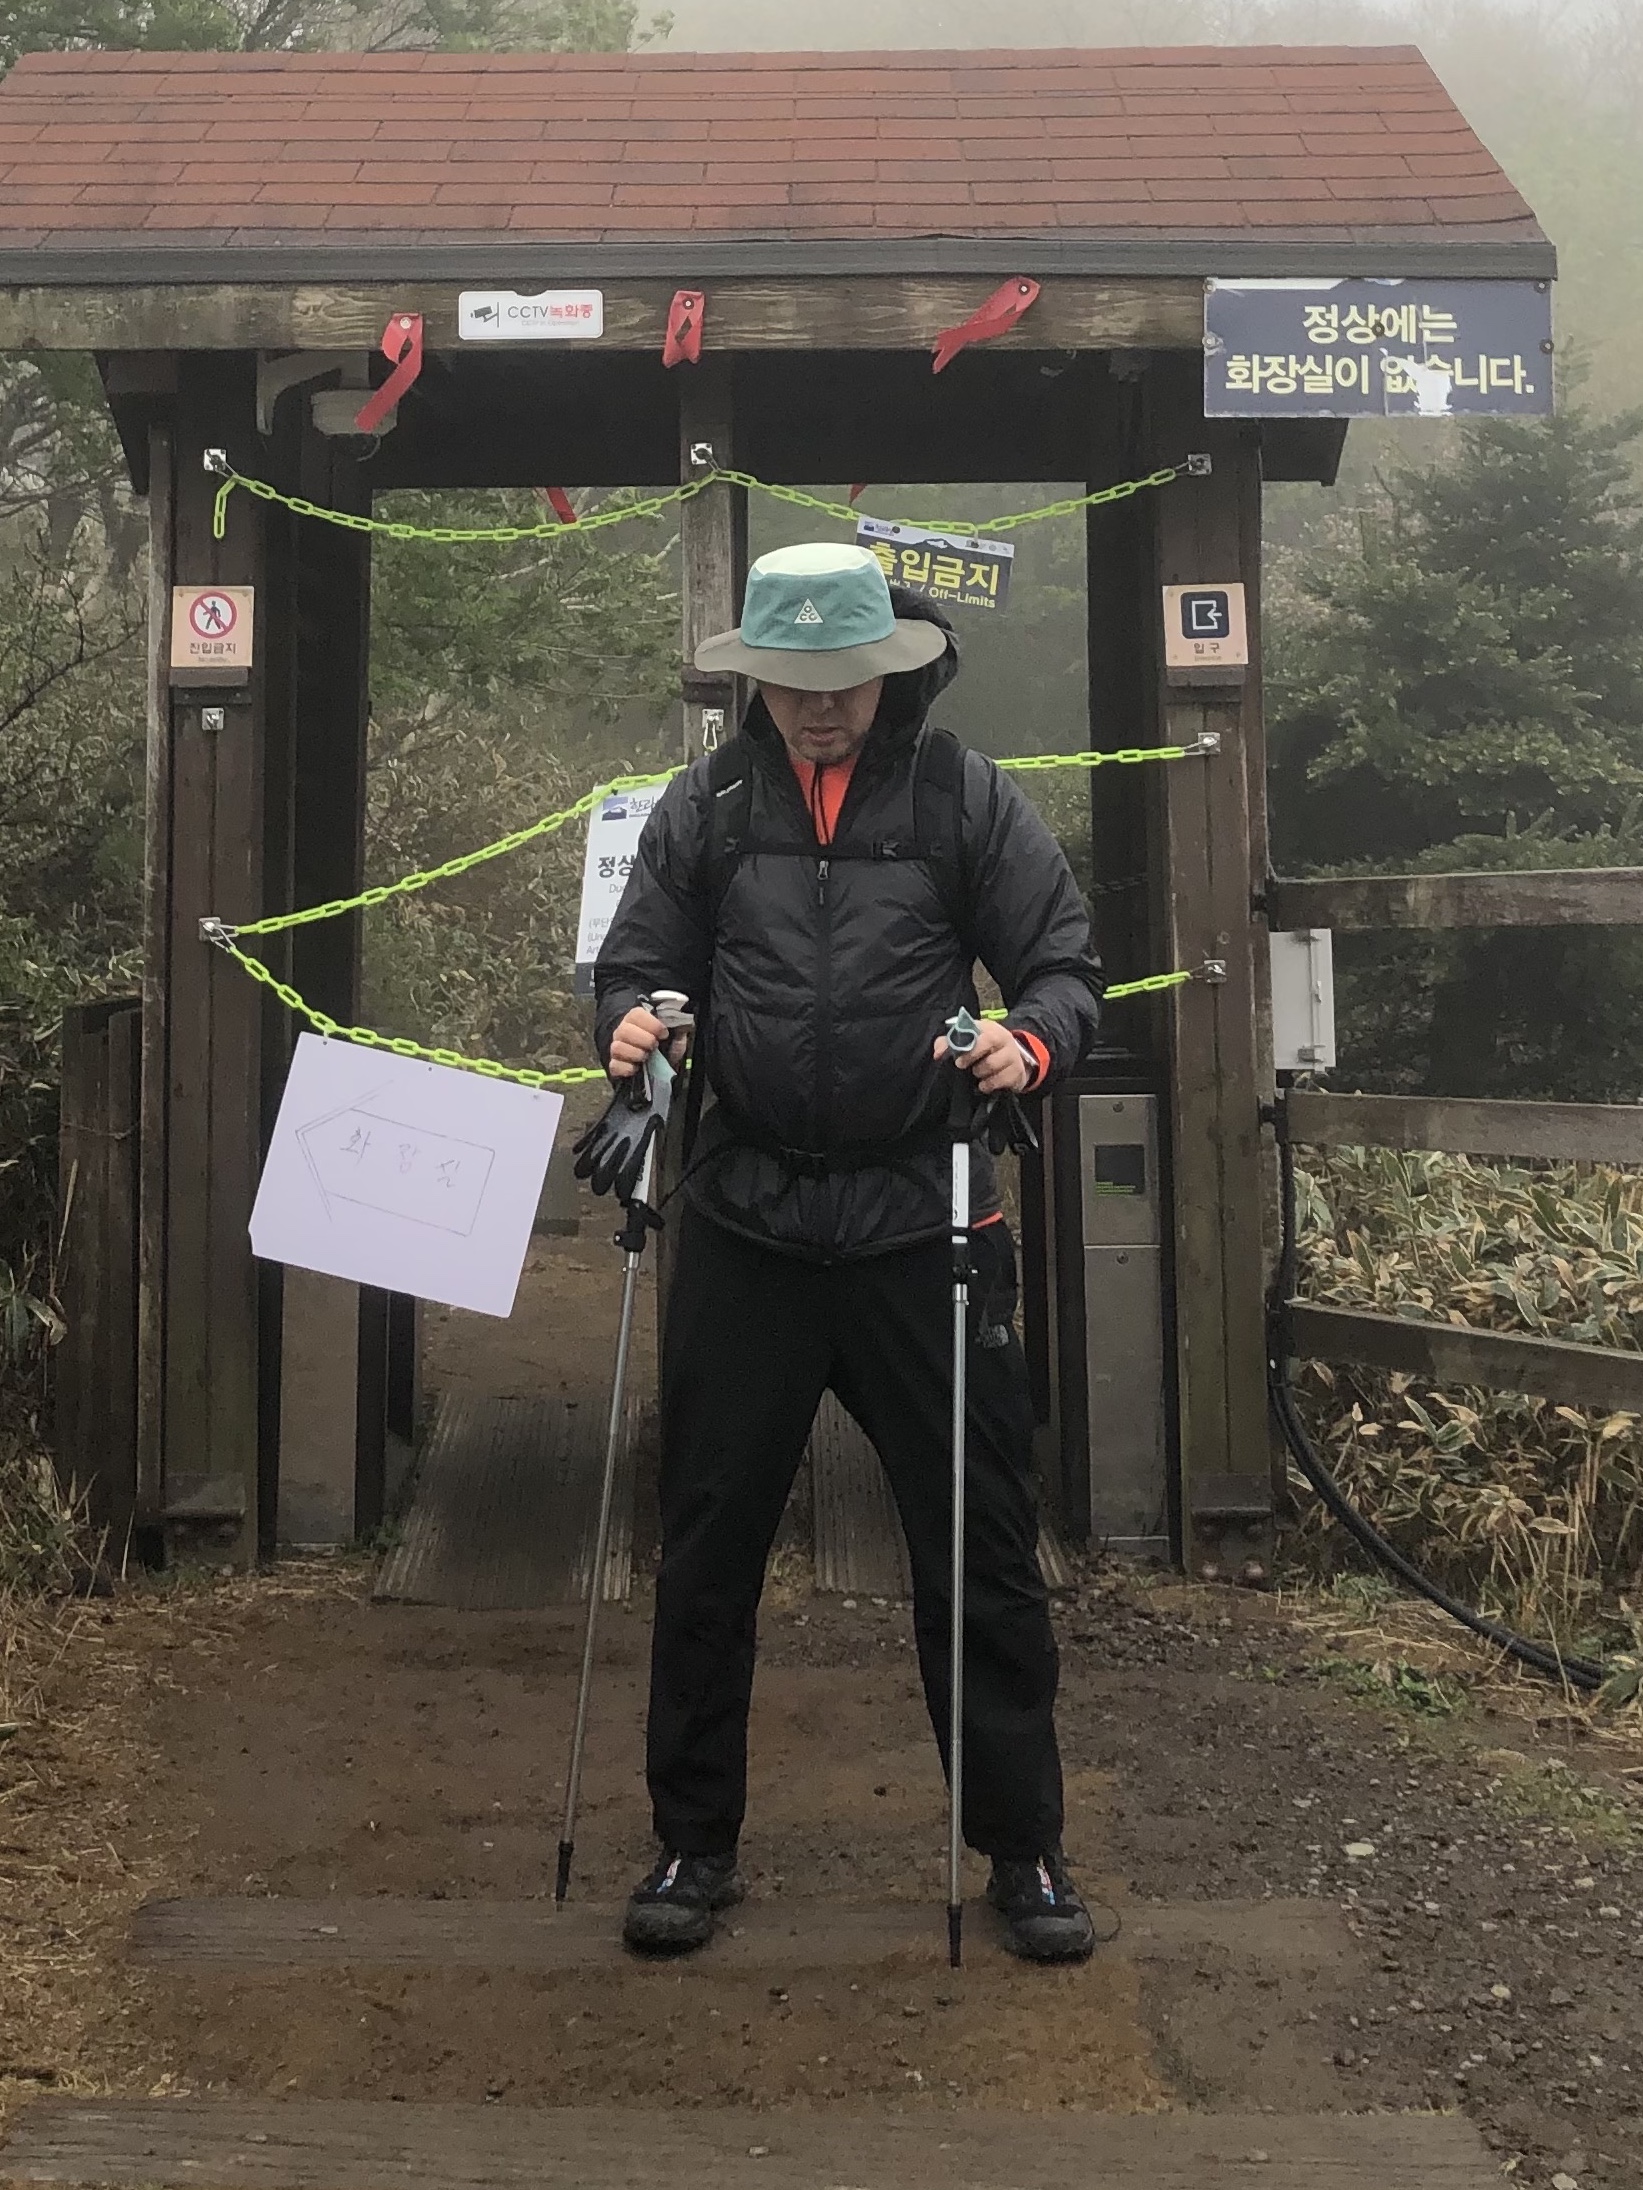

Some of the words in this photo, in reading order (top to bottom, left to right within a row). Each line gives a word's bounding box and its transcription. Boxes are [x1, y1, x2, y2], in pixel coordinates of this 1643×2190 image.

[1302, 304, 1458, 345] 정상에는
[1225, 354, 1370, 395] 화장실이
[870, 541, 1000, 596] 출입금지
[928, 586, 996, 609] Off-Limits
[189, 642, 236, 655] 진입금지
